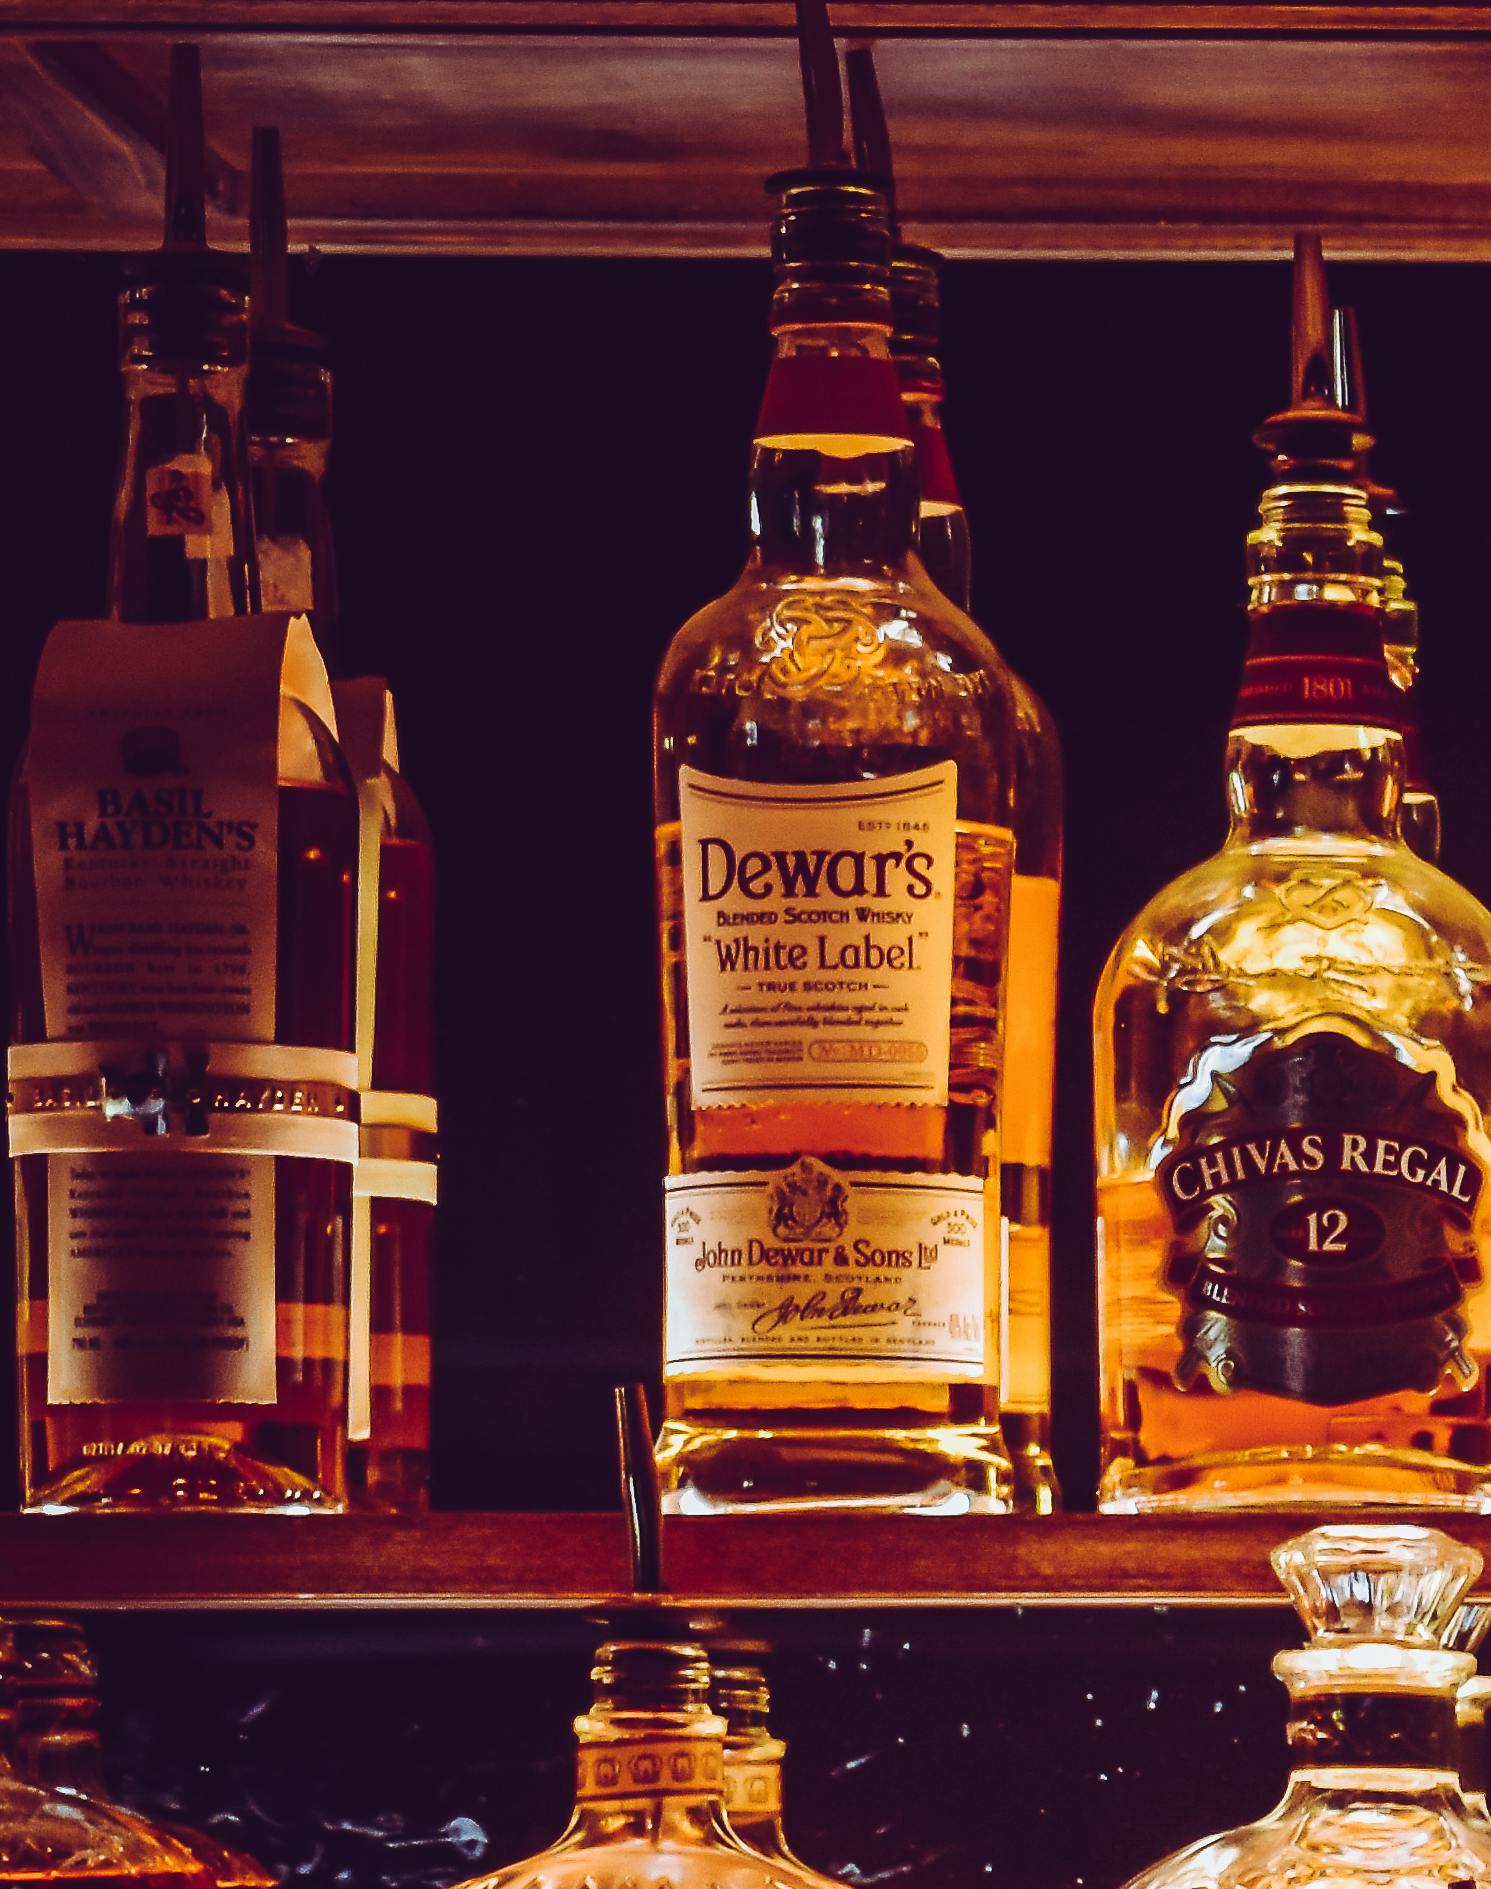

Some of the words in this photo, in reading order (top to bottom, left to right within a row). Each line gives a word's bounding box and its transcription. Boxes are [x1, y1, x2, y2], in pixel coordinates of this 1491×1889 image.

[1302, 675, 1353, 699] 1801
[97, 788, 213, 819] BASIL
[55, 820, 259, 851] HAYDEN'S
[64, 877, 144, 890] Bourbon
[159, 877, 247, 892] Whiskey
[698, 837, 934, 902] Dewar's
[717, 910, 777, 927] BLENDED
[784, 907, 849, 925] SCOTCH
[856, 907, 913, 924] WHISKY
[759, 982, 796, 992] TRUE
[804, 982, 868, 991] SCOTCH
[1172, 1134, 1325, 1201] CHIVAS
[1340, 1132, 1471, 1202] REGAL
[1306, 1209, 1349, 1251] 12
[695, 1240, 742, 1271] John
[748, 1240, 829, 1267] Dewar
[834, 1246, 850, 1266] &
[854, 1240, 913, 1268] Sons
[918, 1242, 938, 1270] Ltd
[824, 1274, 902, 1284] SCOTLAND
